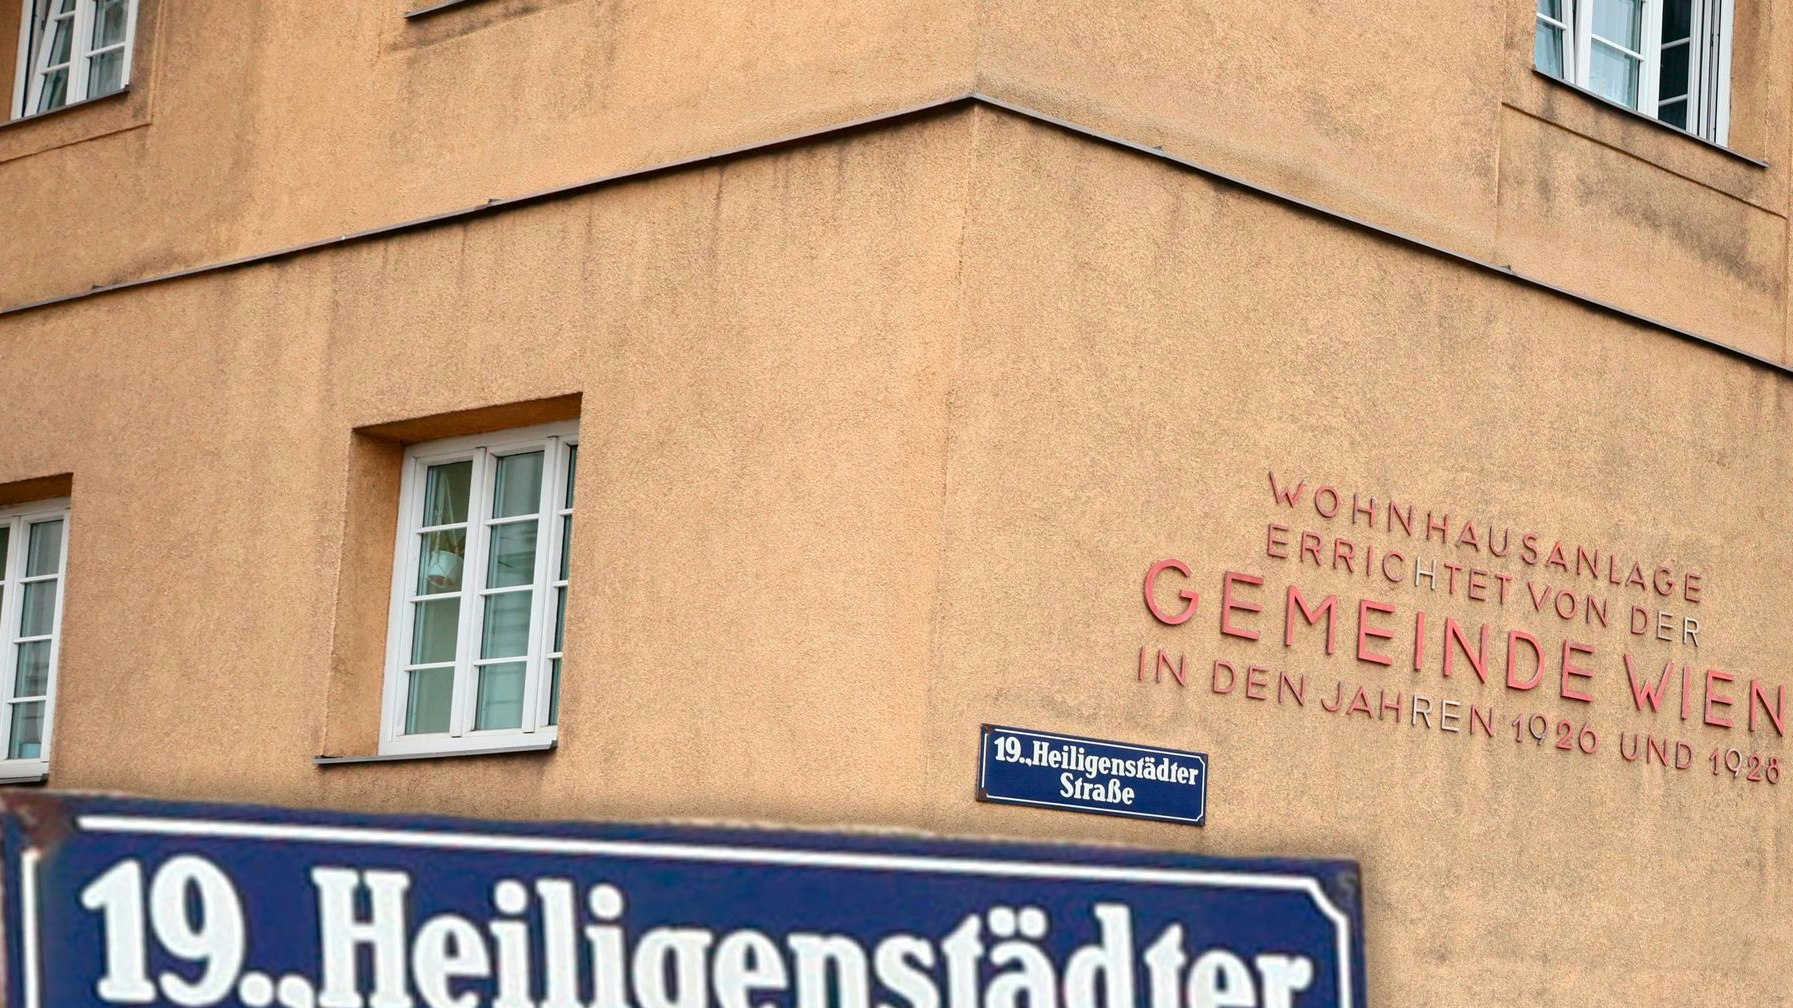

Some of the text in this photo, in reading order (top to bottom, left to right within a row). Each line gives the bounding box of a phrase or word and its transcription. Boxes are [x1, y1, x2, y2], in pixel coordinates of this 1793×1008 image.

[1267, 523, 1701, 647] ERRICHTET VON DER
[1268, 471, 1702, 603] WOHNHAUSANLAGE
[1144, 558, 1787, 739] GEMEINDE WIEN
[1138, 646, 1781, 785] IN DEN JAHREN 1926 UND 1928
[1060, 772, 1135, 805] Straße
